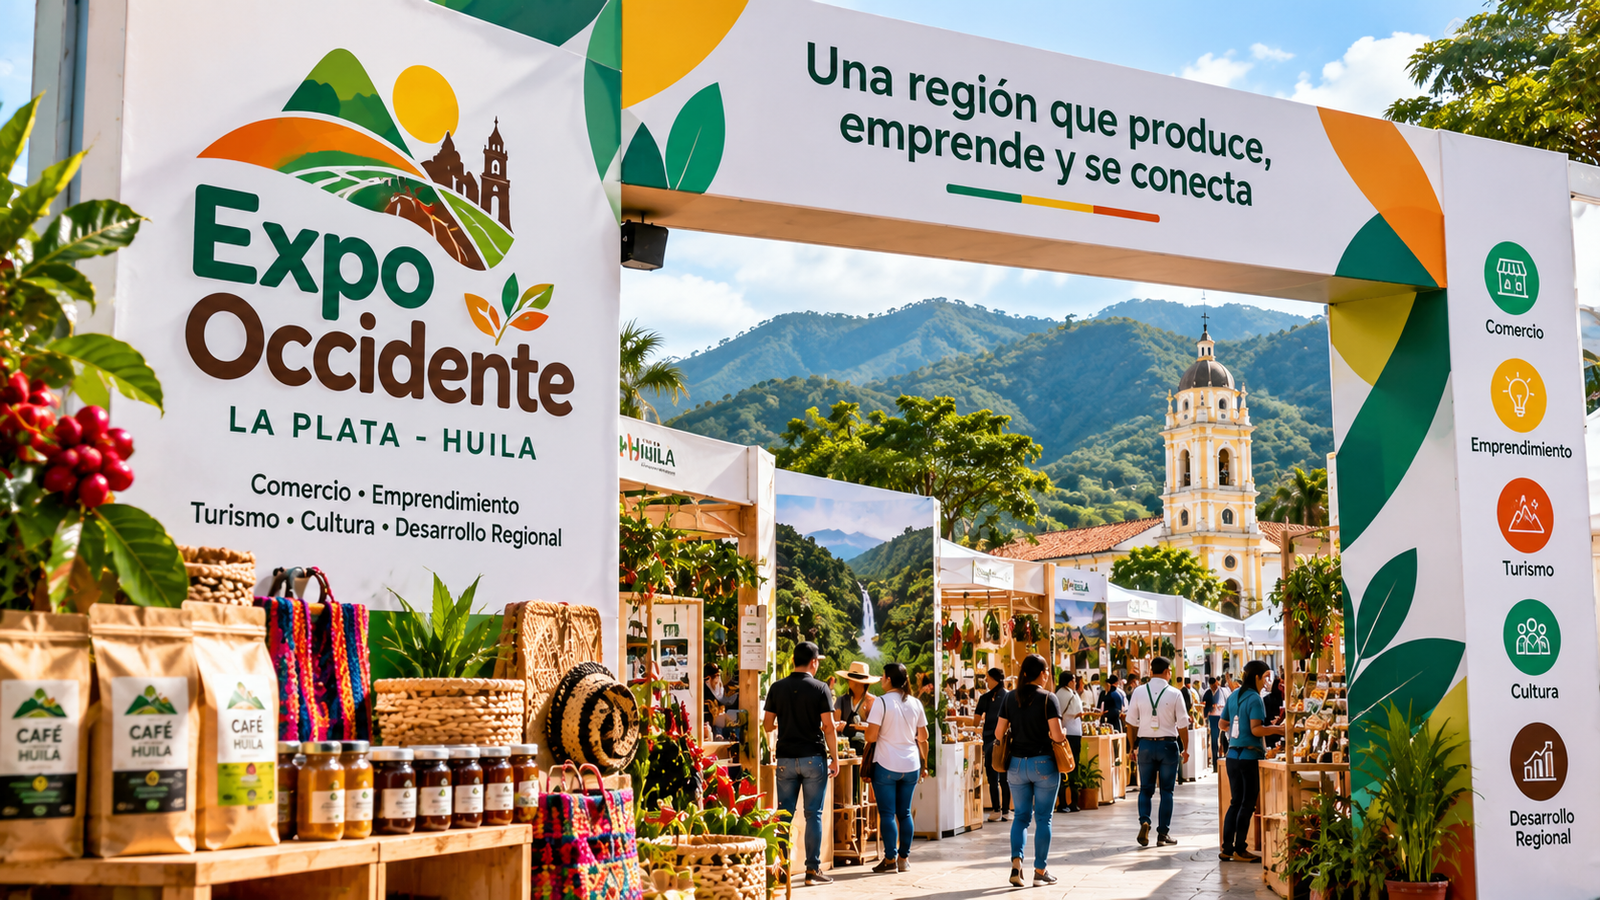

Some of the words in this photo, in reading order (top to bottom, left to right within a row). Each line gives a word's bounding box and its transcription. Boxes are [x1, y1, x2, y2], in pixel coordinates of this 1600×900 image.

[807, 41, 893, 97] Una
[909, 72, 1037, 123] región
[1050, 98, 1118, 139] que
[1129, 115, 1272, 172] produce,
[840, 113, 1045, 172] emprende
[1055, 149, 1076, 186] y
[1085, 154, 1121, 185] se
[1131, 163, 1253, 207] conecta
[193, 183, 434, 320] Expo
[1485, 319, 1545, 340] Comercio
[185, 292, 574, 416] Occidente
[230, 406, 274, 435] LA
[293, 412, 400, 447] PLATA
[443, 428, 537, 460] HUILA
[1471, 437, 1573, 459] Emprendimiento
[251, 473, 351, 502] Comercio
[372, 484, 520, 514] Emprendimiento
[191, 501, 280, 529] Turismo
[301, 511, 375, 535] Cultura
[395, 518, 486, 541] Desarrollo
[491, 524, 562, 549] Regional
[1502, 560, 1555, 577] Turismo
[1510, 683, 1559, 700] Cultura
[16, 725, 62, 744] CAFÉ
[129, 721, 173, 740] CAFÉ
[231, 716, 264, 734] CAFÉ
[131, 745, 172, 758] HUILA
[233, 739, 263, 750] HUILA
[18, 749, 61, 762] HUILA
[1509, 807, 1575, 827] Desarrollo
[1515, 827, 1572, 849] Regional
